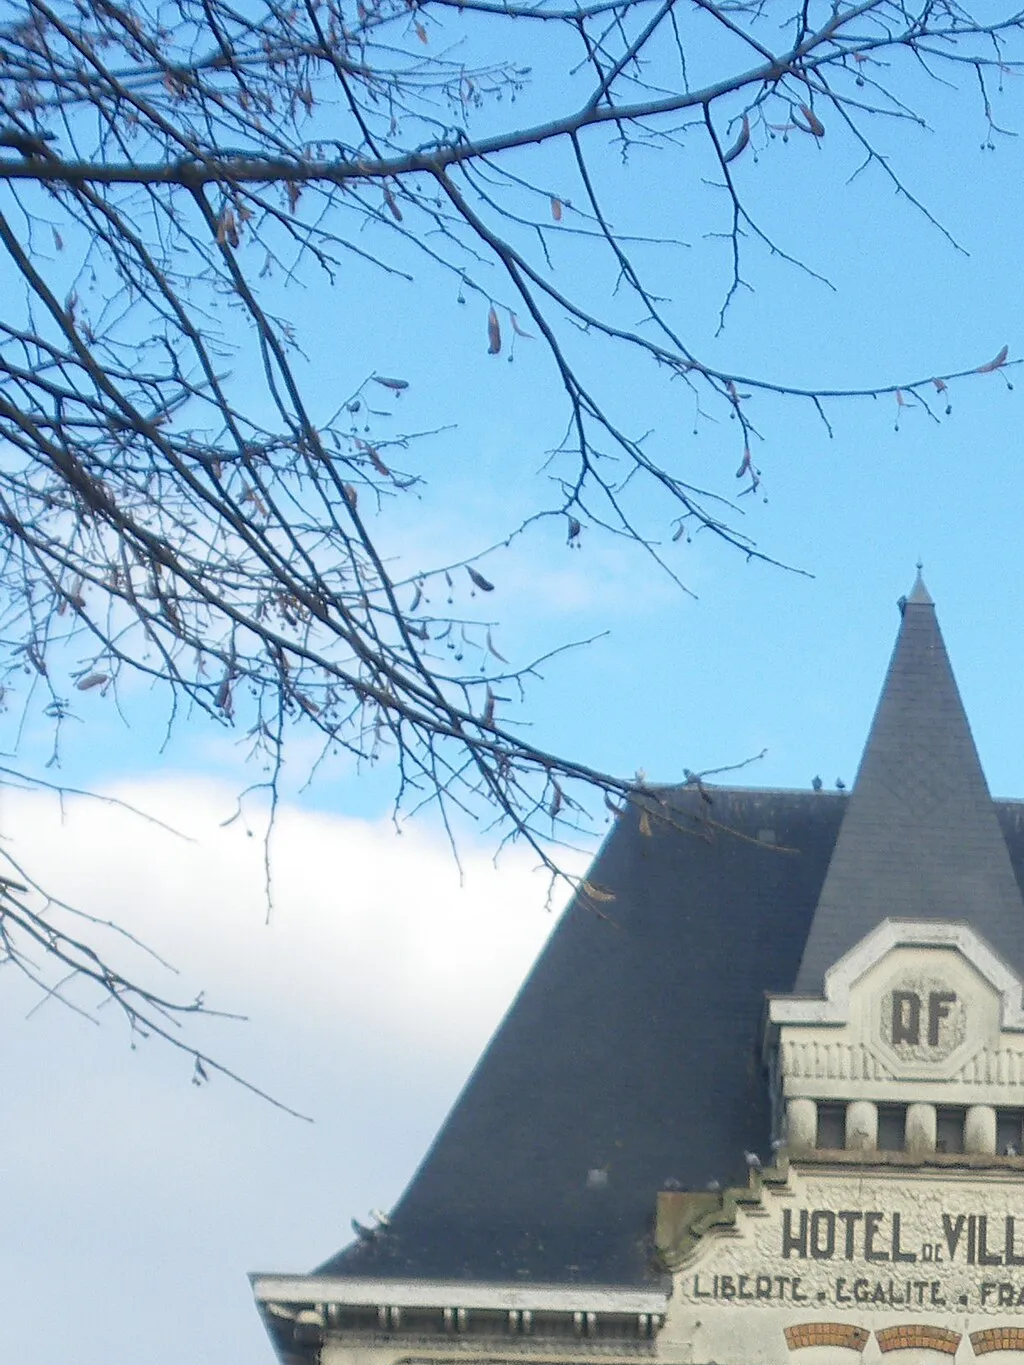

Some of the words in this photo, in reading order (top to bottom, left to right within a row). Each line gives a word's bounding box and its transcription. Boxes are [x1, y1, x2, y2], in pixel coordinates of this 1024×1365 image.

[782, 1209, 917, 1263] HOTEL
[922, 1243, 944, 1263] DE
[693, 1275, 808, 1301] LIBERTE
[835, 1278, 947, 1306] EGALITE
